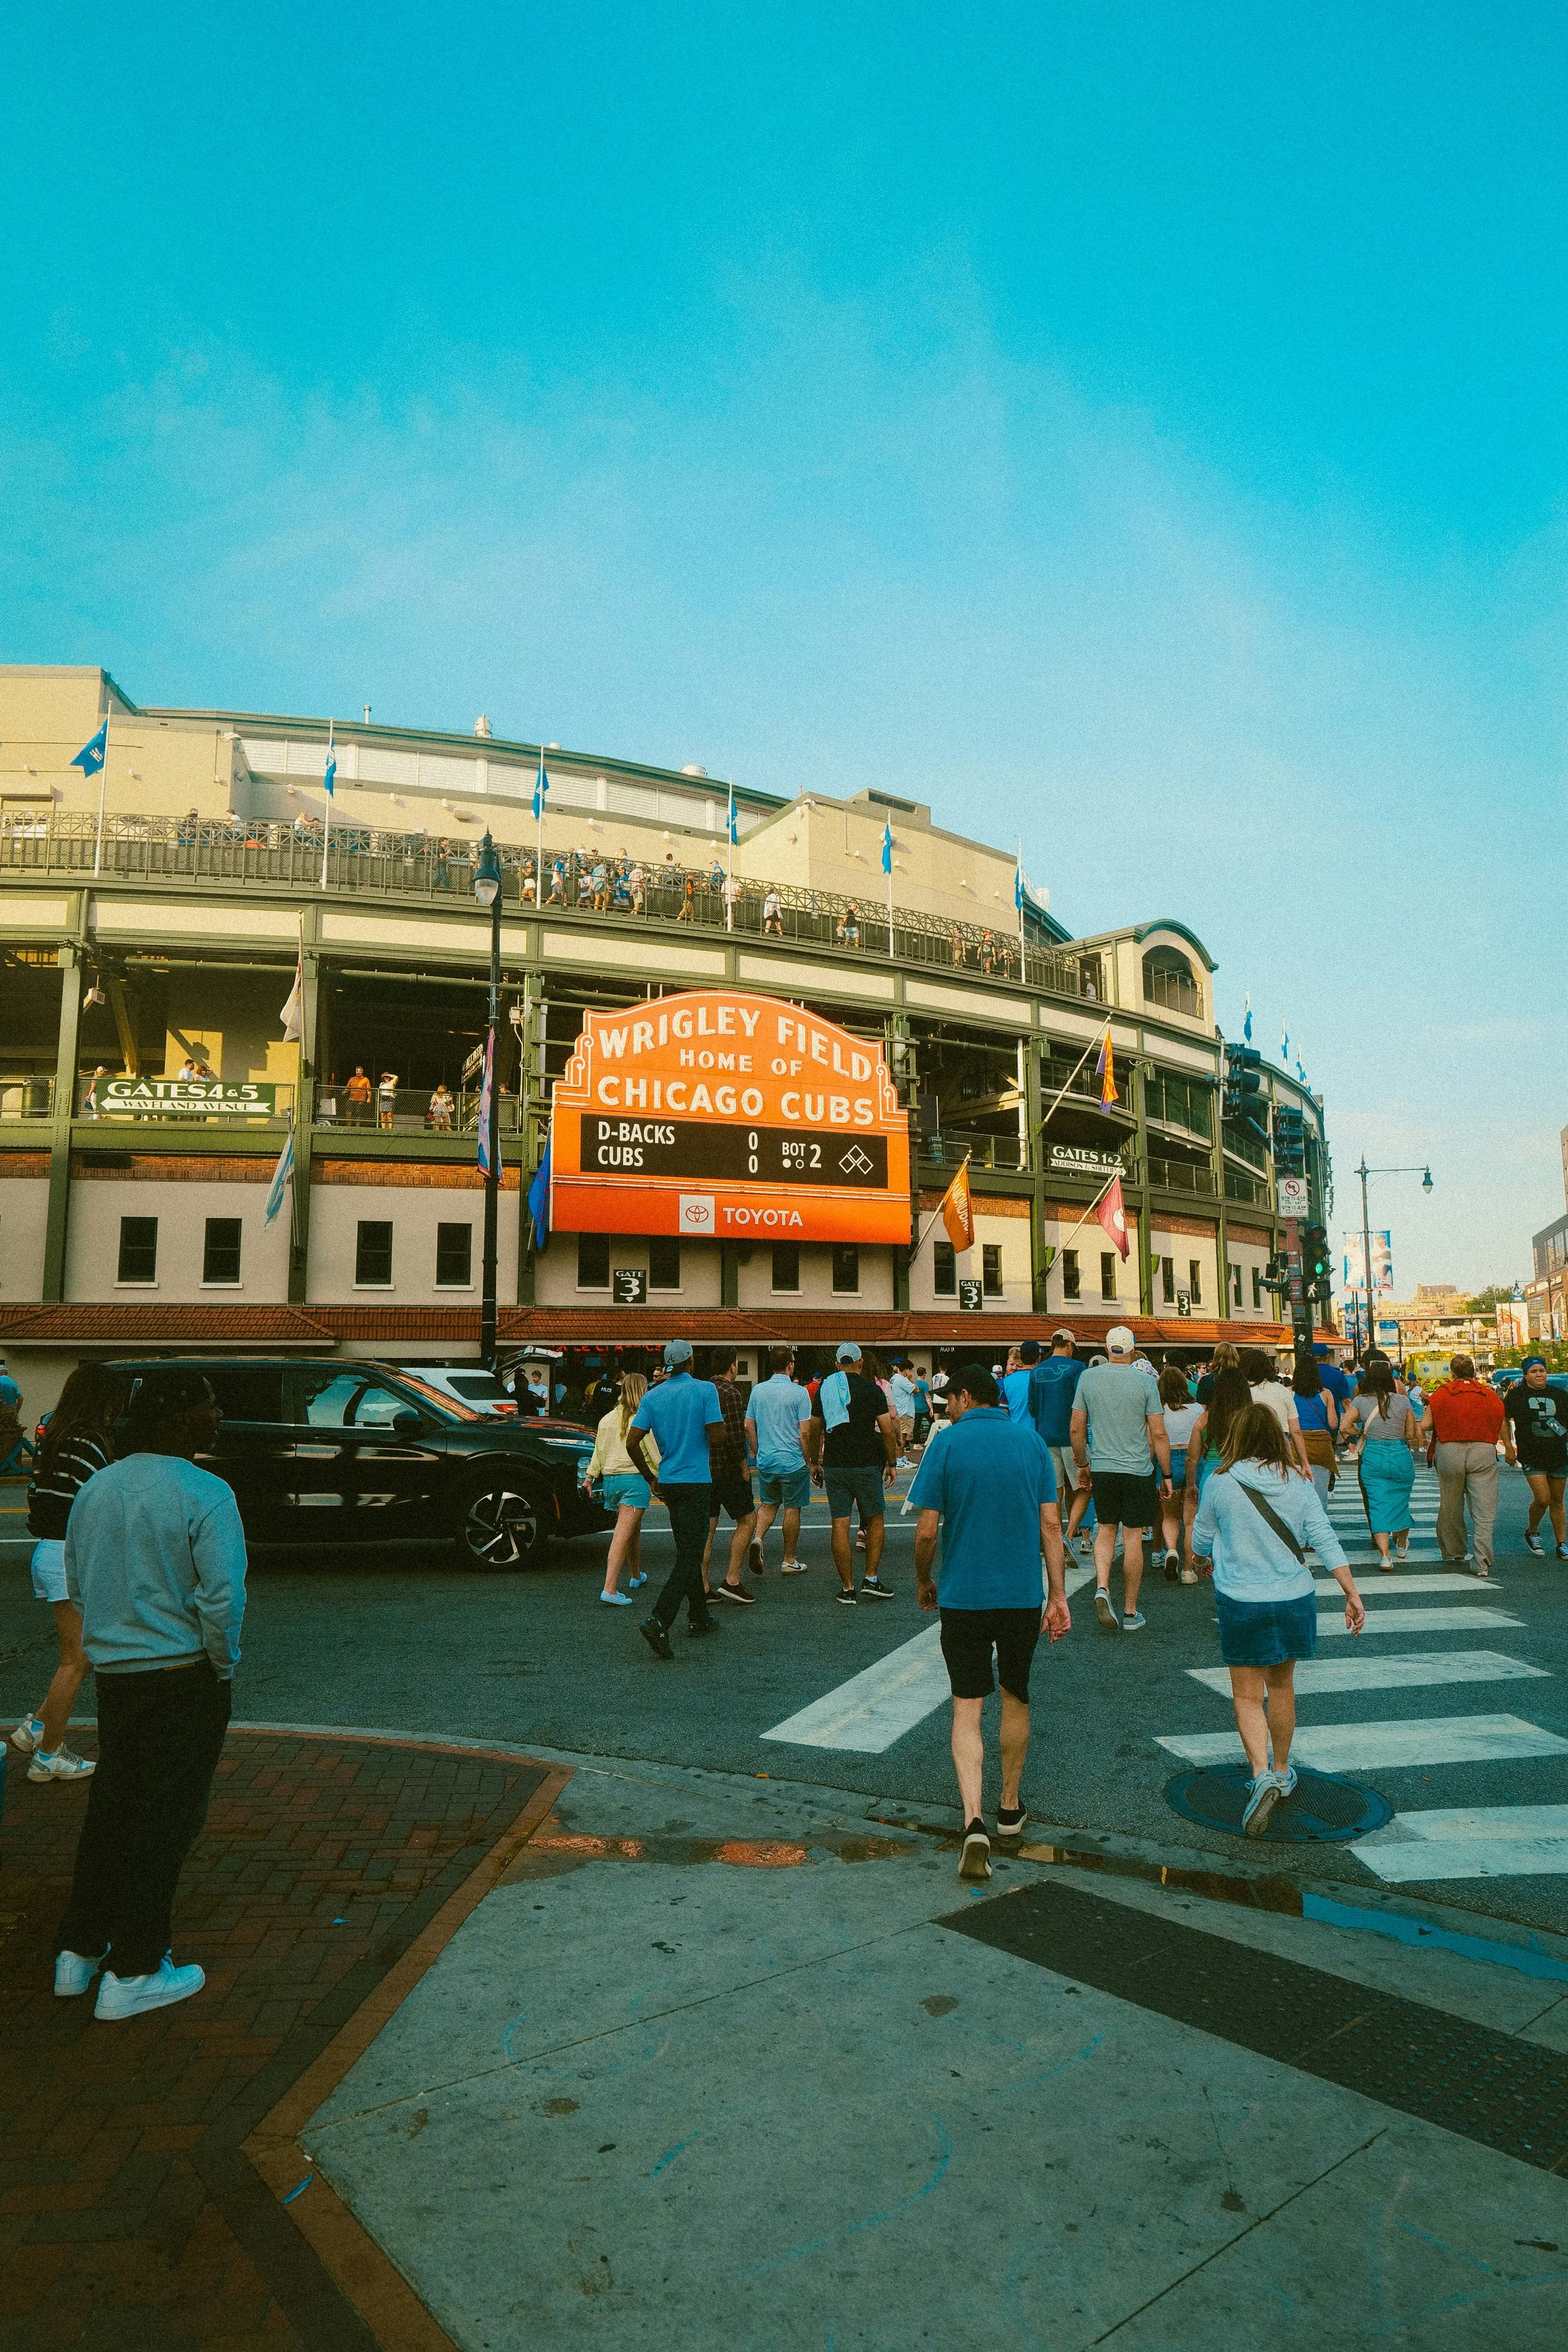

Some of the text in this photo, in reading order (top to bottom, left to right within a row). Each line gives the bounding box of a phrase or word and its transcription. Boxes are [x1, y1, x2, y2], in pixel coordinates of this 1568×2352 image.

[598, 1006, 871, 1082] WRIGLEY FIELD
[680, 1049, 803, 1076] HOME OF
[123, 1100, 251, 1111] WAVELAND AVENUE
[598, 1075, 874, 1125] CHICAGO CUBS
[598, 1121, 758, 1150] D-BACKS 0
[598, 1145, 758, 1173] CUBS 0
[782, 1142, 822, 1168] BOT 2
[1052, 1146, 1099, 1163] GATES
[1054, 1160, 1083, 1168] ADDISON
[1092, 1165, 1123, 1175] SHEFFIED
[723, 1207, 803, 1227] TOYOTA
[620, 1278, 640, 1296] 3
[964, 1287, 978, 1304] 3
[1180, 1296, 1189, 1311] 3
[1528, 1397, 1556, 1438] 3
